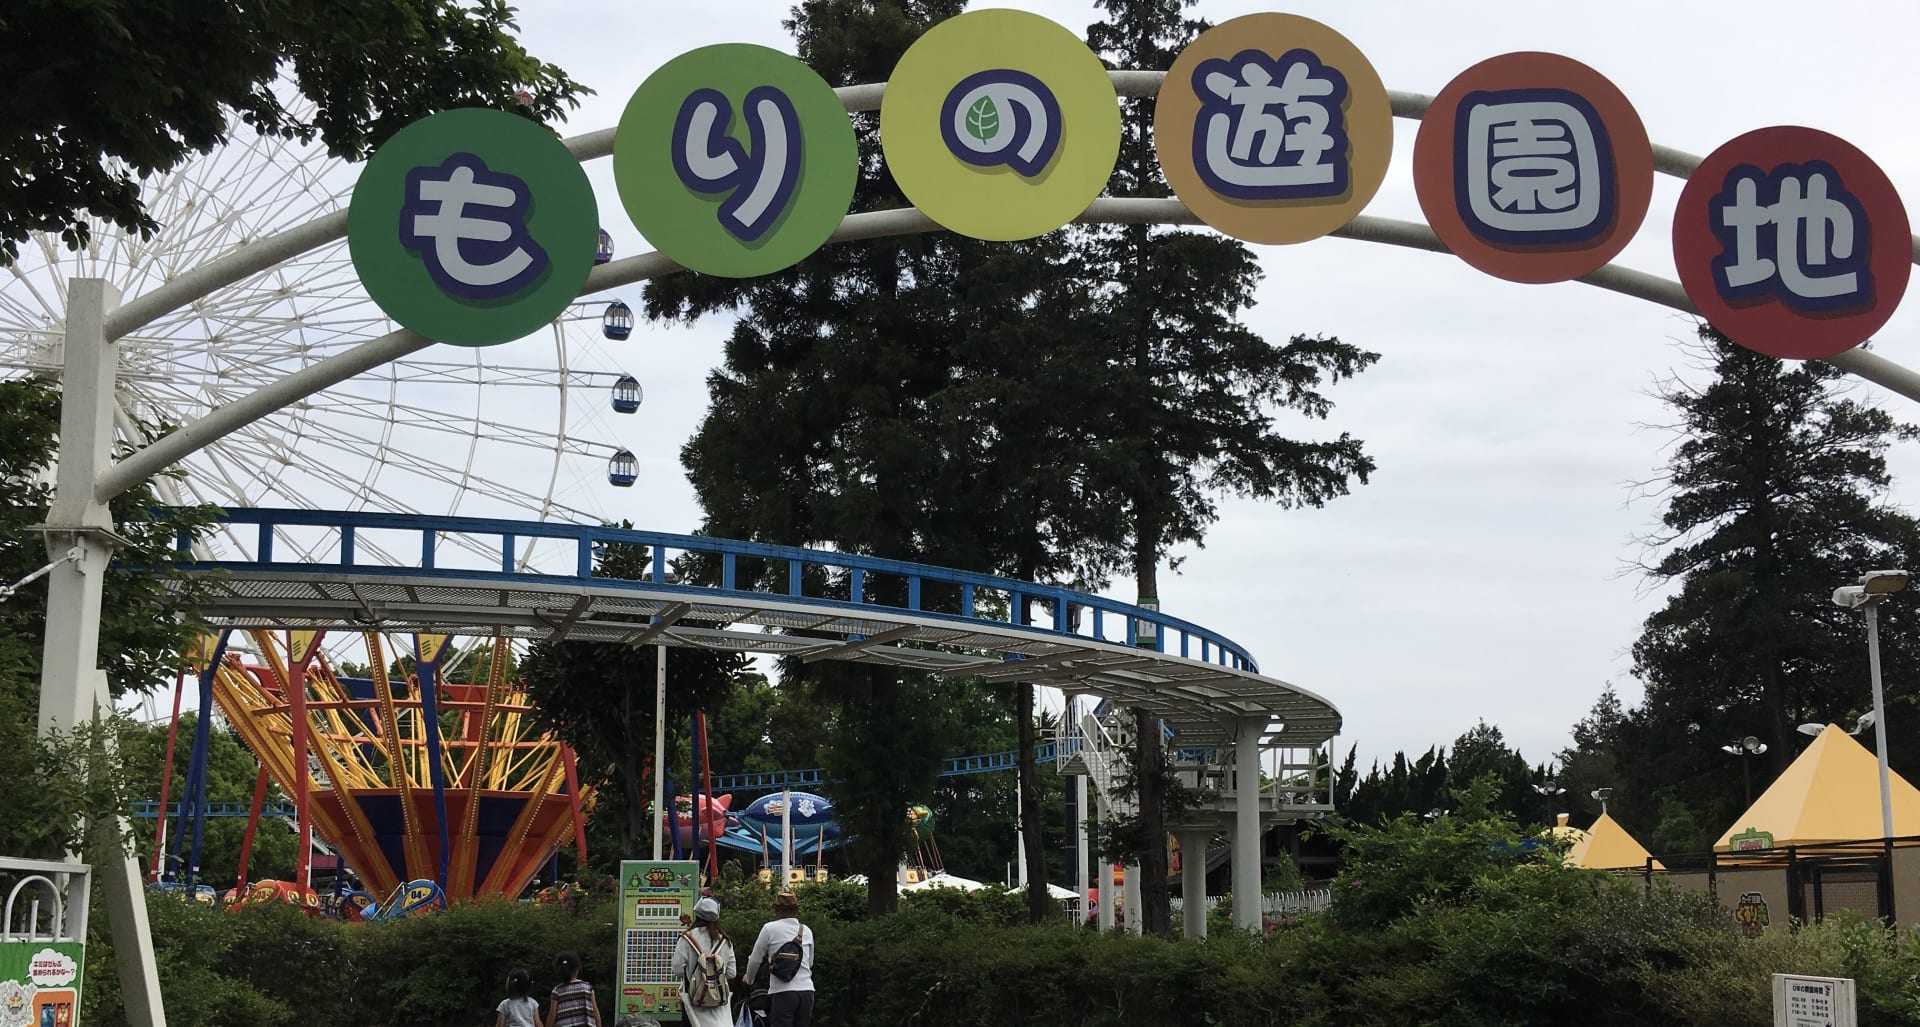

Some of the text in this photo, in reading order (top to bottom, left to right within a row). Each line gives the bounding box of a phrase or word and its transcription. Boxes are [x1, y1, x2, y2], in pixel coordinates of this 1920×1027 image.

[408, 52, 1866, 304] もりの遊園地
[411, 891, 422, 899] 04
